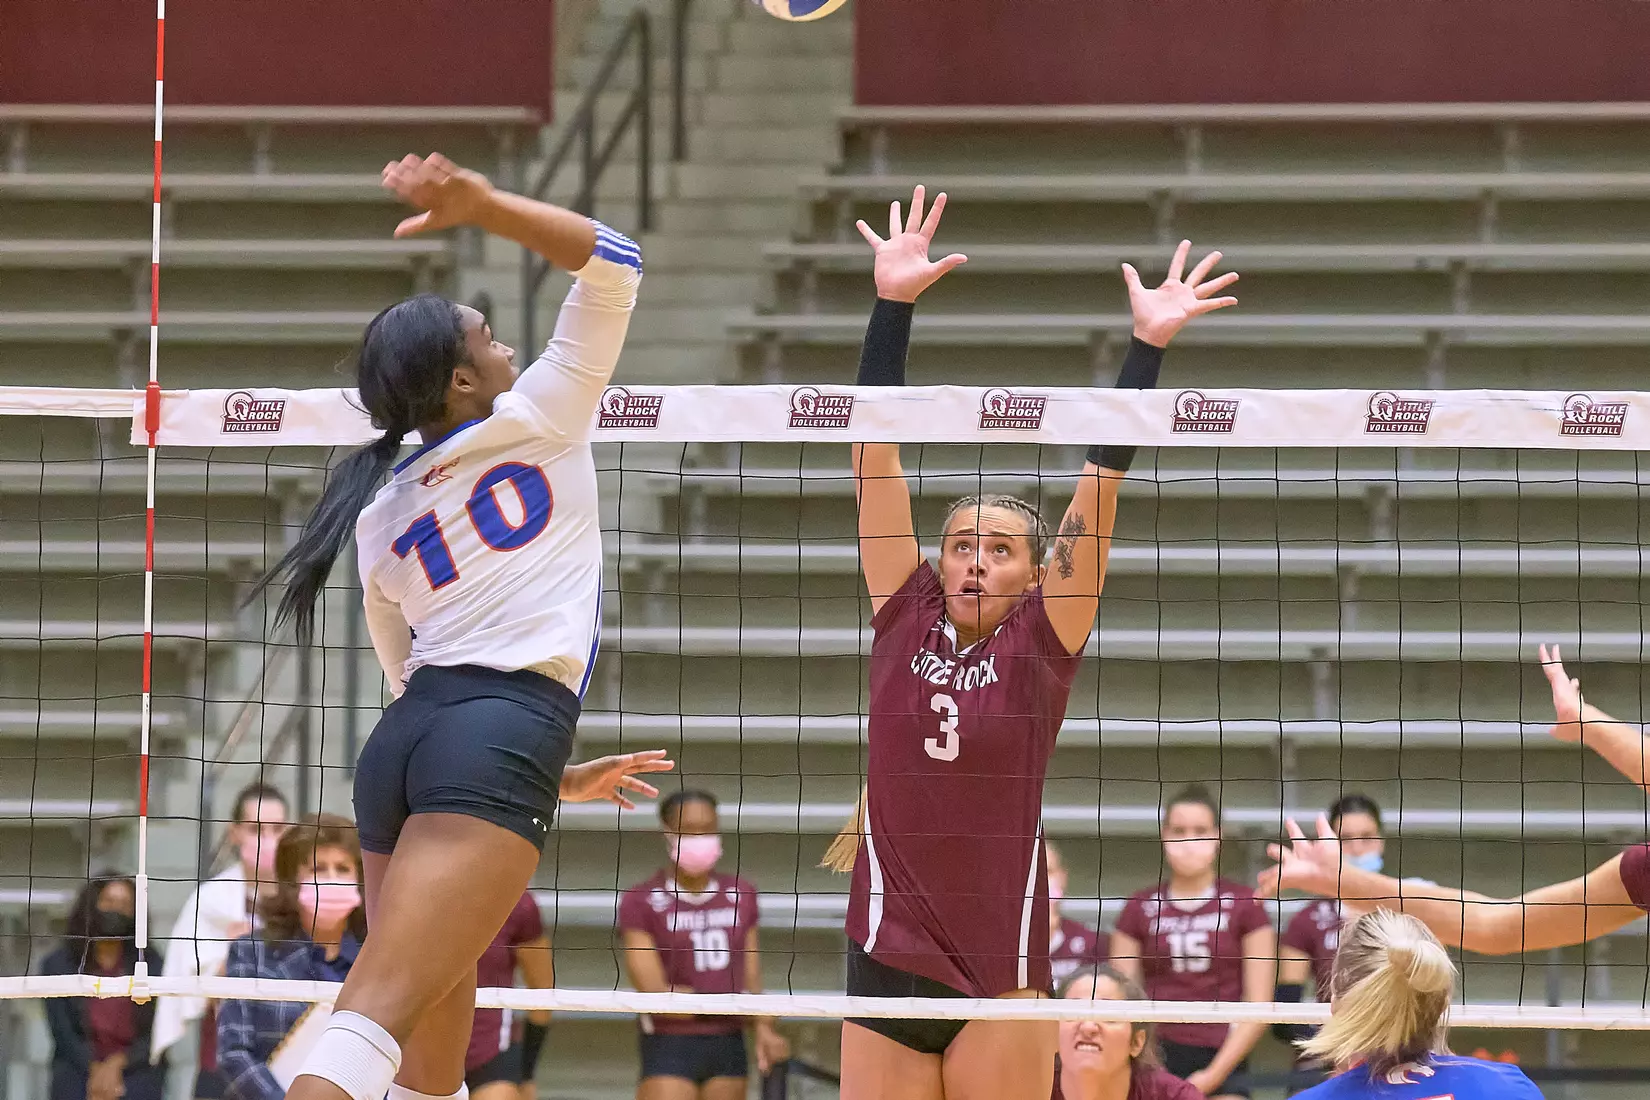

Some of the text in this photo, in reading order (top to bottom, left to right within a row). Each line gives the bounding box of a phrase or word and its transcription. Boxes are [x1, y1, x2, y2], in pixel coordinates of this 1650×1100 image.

[250, 401, 284, 411] LITTLE
[628, 397, 661, 406] LITTLE
[818, 397, 852, 407] LITTLE
[1010, 399, 1044, 408] LITTLE
[1202, 401, 1237, 411] LITTLE
[626, 407, 658, 415] ROCK
[816, 407, 850, 415] ROCK
[1396, 402, 1431, 412] LITTLE
[1590, 405, 1626, 414] LITTLE
[248, 411, 281, 420] ROCK
[1007, 408, 1041, 417] ROCK
[1200, 411, 1235, 420] ROCK
[1394, 412, 1429, 420] ROCK
[601, 419, 654, 427] VOLLEYBALL
[792, 419, 846, 427] VOLLEYBALL
[1588, 414, 1623, 423] ROCK
[226, 423, 277, 431] VOLLEYBALL
[983, 420, 1037, 428] VOLLEYBALL
[1176, 423, 1230, 431] VOLLEYBALL
[1369, 423, 1424, 432] VOLLEYBALL
[1564, 426, 1618, 434] VOLLEYBALL
[391, 461, 554, 592] 10
[952, 653, 999, 692] ROCK
[924, 693, 960, 762] 3
[689, 929, 730, 972] 10
[1166, 932, 1212, 973] 15
